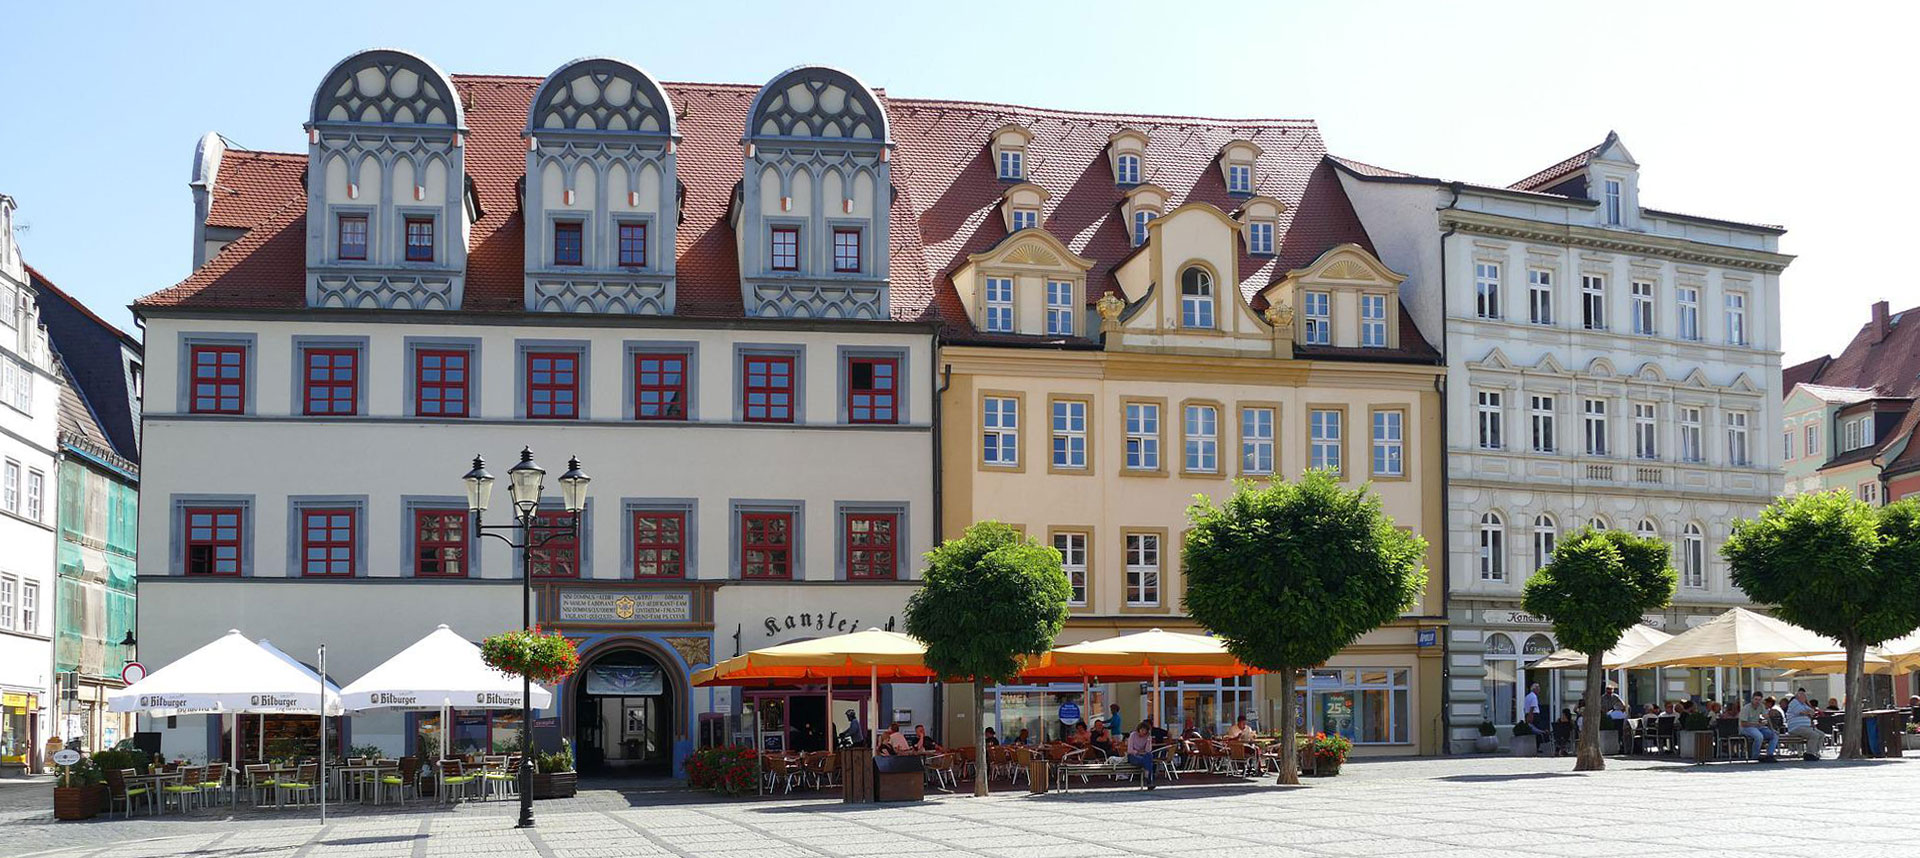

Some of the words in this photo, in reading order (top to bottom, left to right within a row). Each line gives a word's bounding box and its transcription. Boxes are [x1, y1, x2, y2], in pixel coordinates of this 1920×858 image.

[764, 611, 859, 637] Kanzlei
[150, 695, 187, 708] Bitburger
[261, 695, 297, 708] Bitburger
[380, 693, 417, 705] Bitburger
[486, 693, 521, 705] Bitburger
